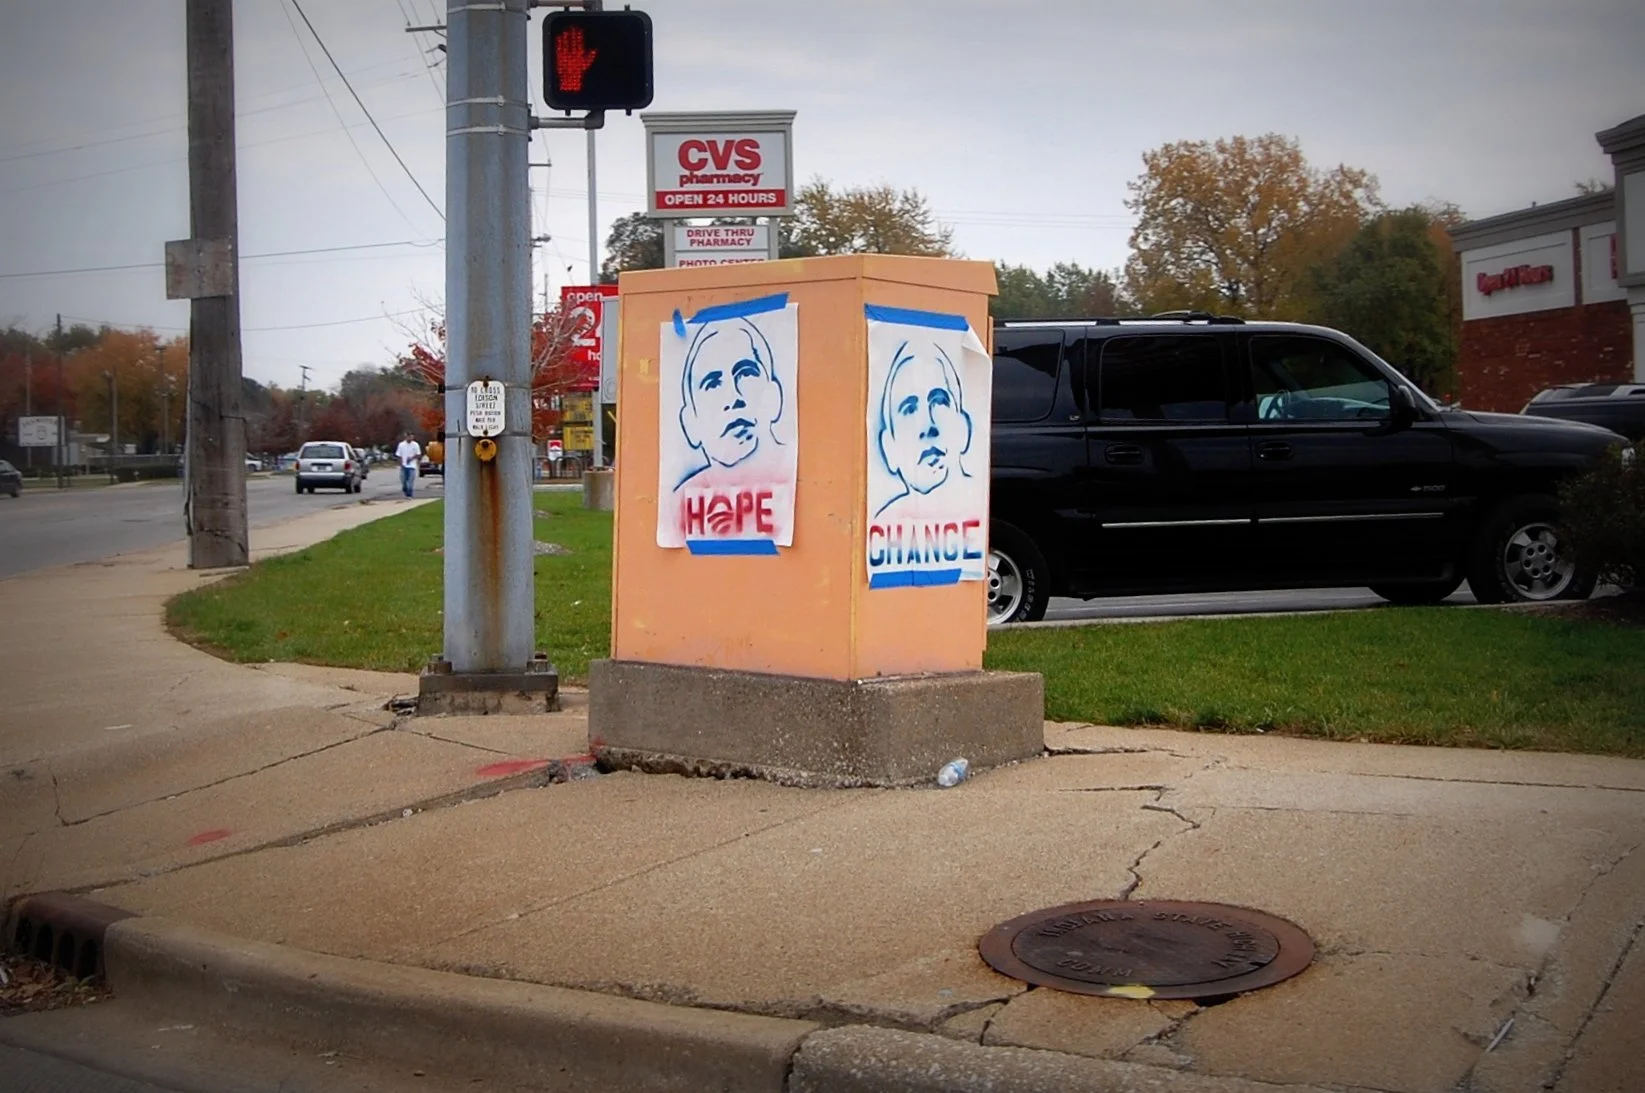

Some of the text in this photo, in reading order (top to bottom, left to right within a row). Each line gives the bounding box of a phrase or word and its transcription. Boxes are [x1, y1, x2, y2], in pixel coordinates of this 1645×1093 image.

[678, 138, 762, 171] CVS
[679, 171, 761, 187] pharmacy
[664, 193, 777, 205] OPEN 24 HOURS
[687, 228, 755, 238] DRIVE THRU
[689, 238, 753, 247] PHARMACY
[566, 291, 604, 303] open
[686, 491, 774, 535] HOPE
[868, 520, 982, 567] CHANGE
[1153, 911, 1233, 932] STATE
